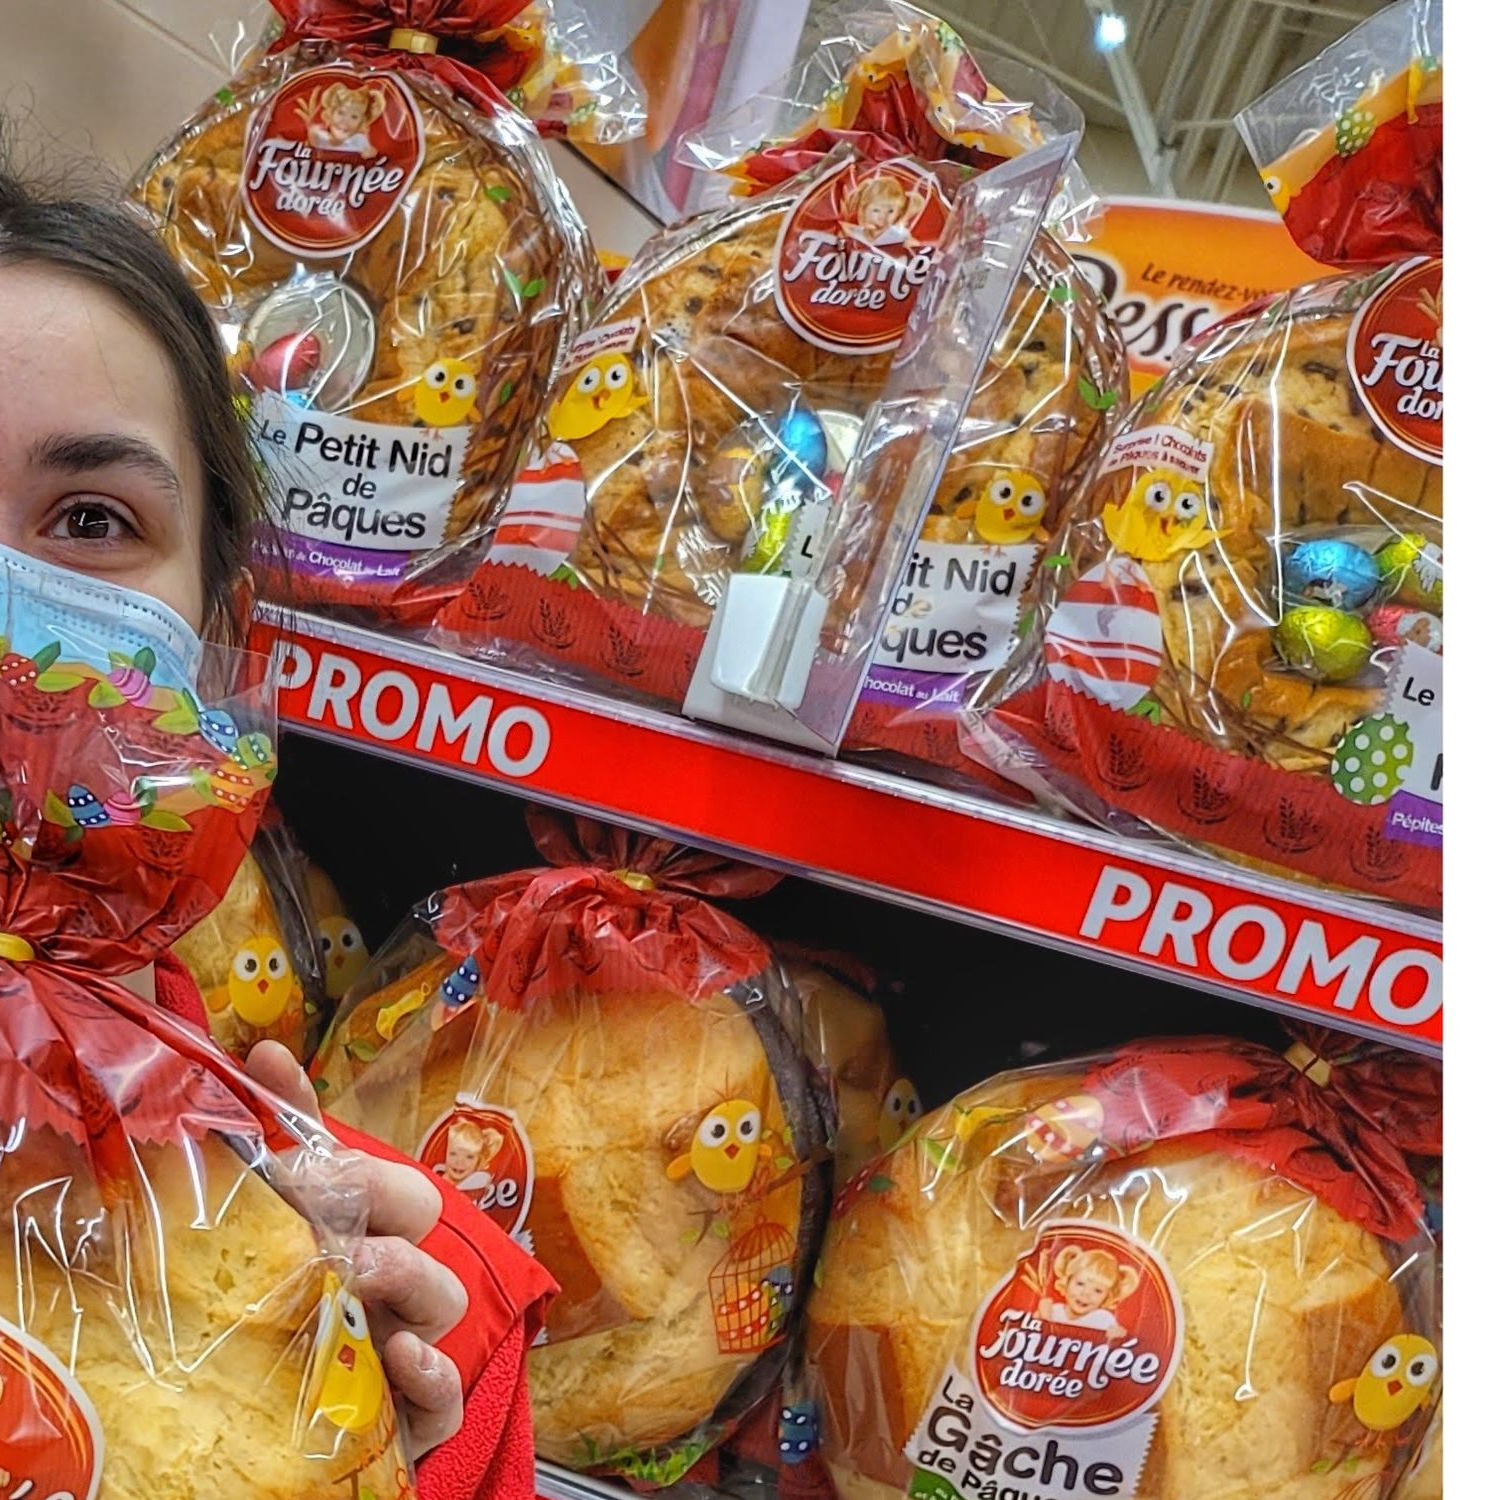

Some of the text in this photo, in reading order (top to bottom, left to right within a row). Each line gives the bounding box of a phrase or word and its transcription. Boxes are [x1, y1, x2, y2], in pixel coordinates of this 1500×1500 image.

[295, 142, 311, 158] la
[249, 139, 404, 208] Fournée
[277, 186, 346, 217] dorée
[1141, 262, 1167, 284] Le
[810, 279, 886, 309] dorée
[1420, 340, 1439, 359] la
[260, 421, 453, 478] Le Petit Nid
[343, 473, 377, 500] de
[284, 487, 427, 541] Pâques
[309, 552, 363, 571] Chocolat
[944, 558, 1016, 597] Nid
[881, 627, 987, 663] ques
[262, 640, 551, 778] PROMO
[1403, 677, 1435, 706] Le
[1079, 864, 1443, 1026] PROMO
[1021, 1313, 1042, 1331] la
[979, 1307, 1160, 1389] Fournée
[942, 1375, 975, 1413] La
[999, 1359, 1084, 1398] dorée
[918, 1449, 957, 1474] de
[927, 1405, 1124, 1496] Gâche
